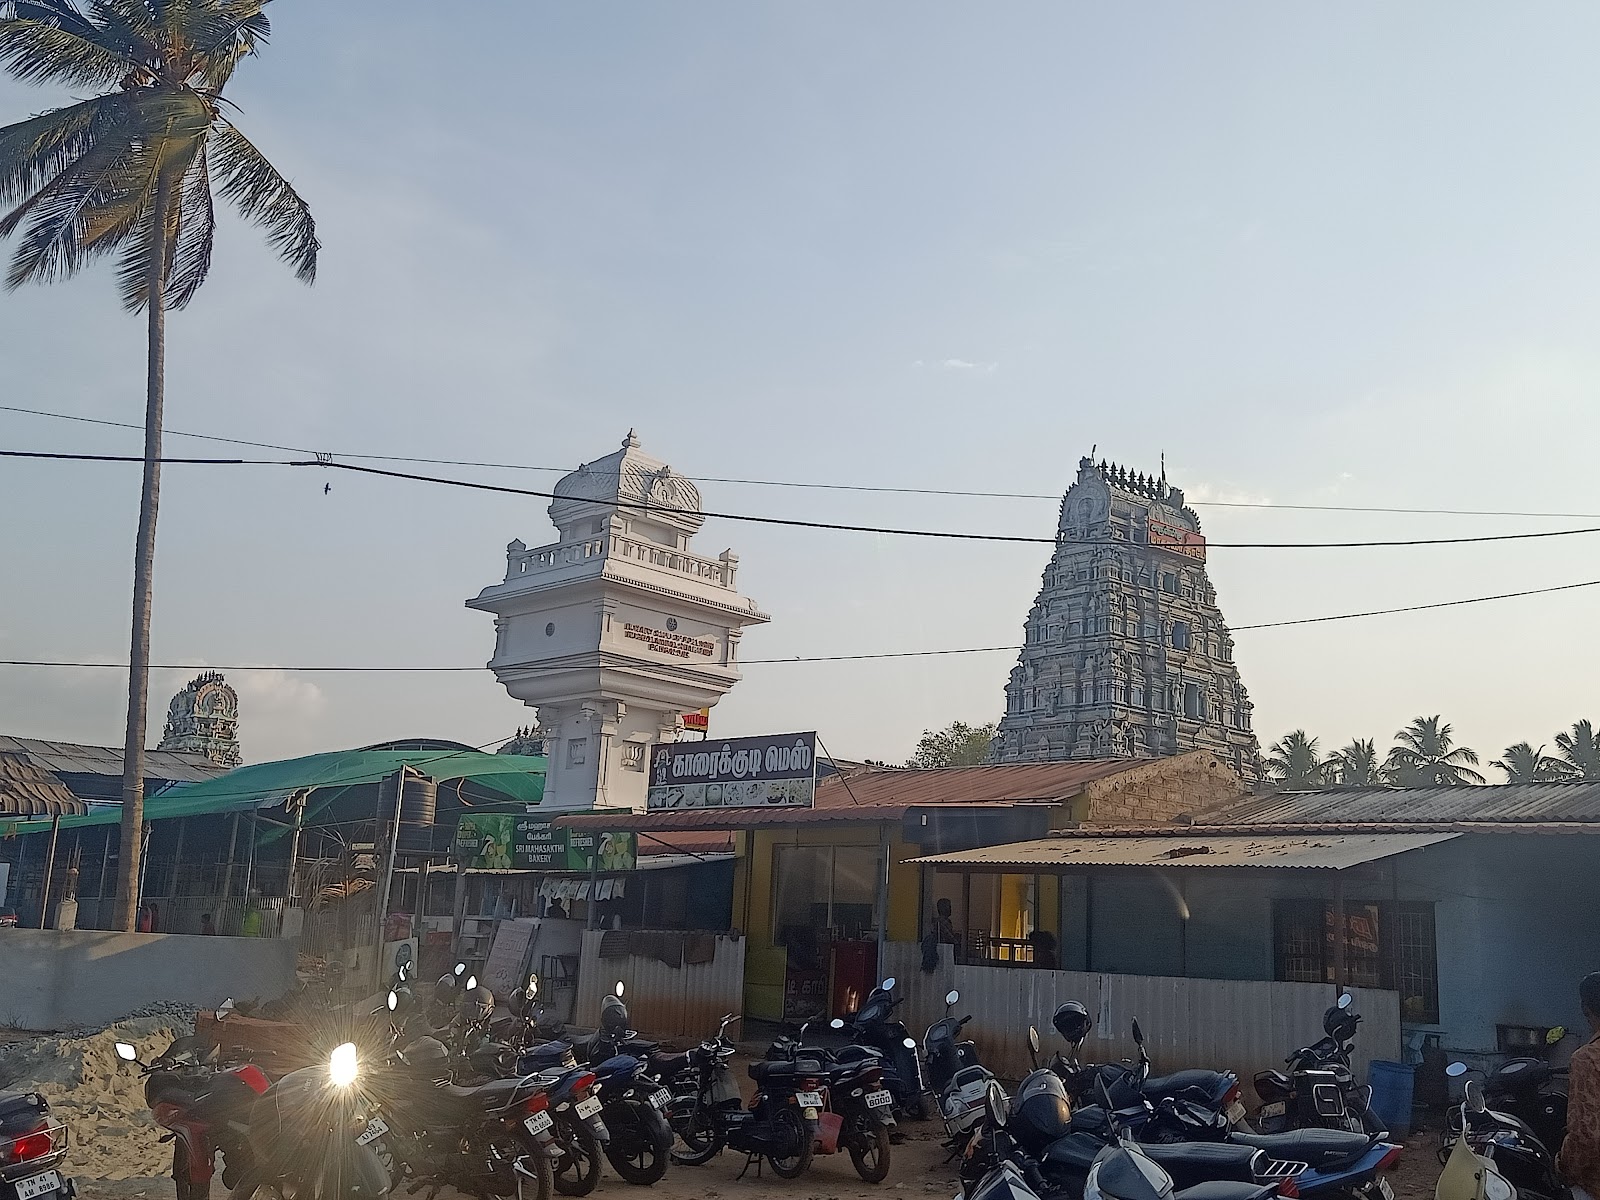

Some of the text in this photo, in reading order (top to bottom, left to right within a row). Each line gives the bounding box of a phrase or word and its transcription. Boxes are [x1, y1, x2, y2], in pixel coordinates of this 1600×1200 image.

[672, 739, 812, 779] காரைக்குடி மெஸ்
[515, 844, 565, 853] SRI MAHASAKTHI
[528, 854, 552, 863] BAKERY
[26, 1178, 36, 1187] TN
[24, 1188, 35, 1199] AM
